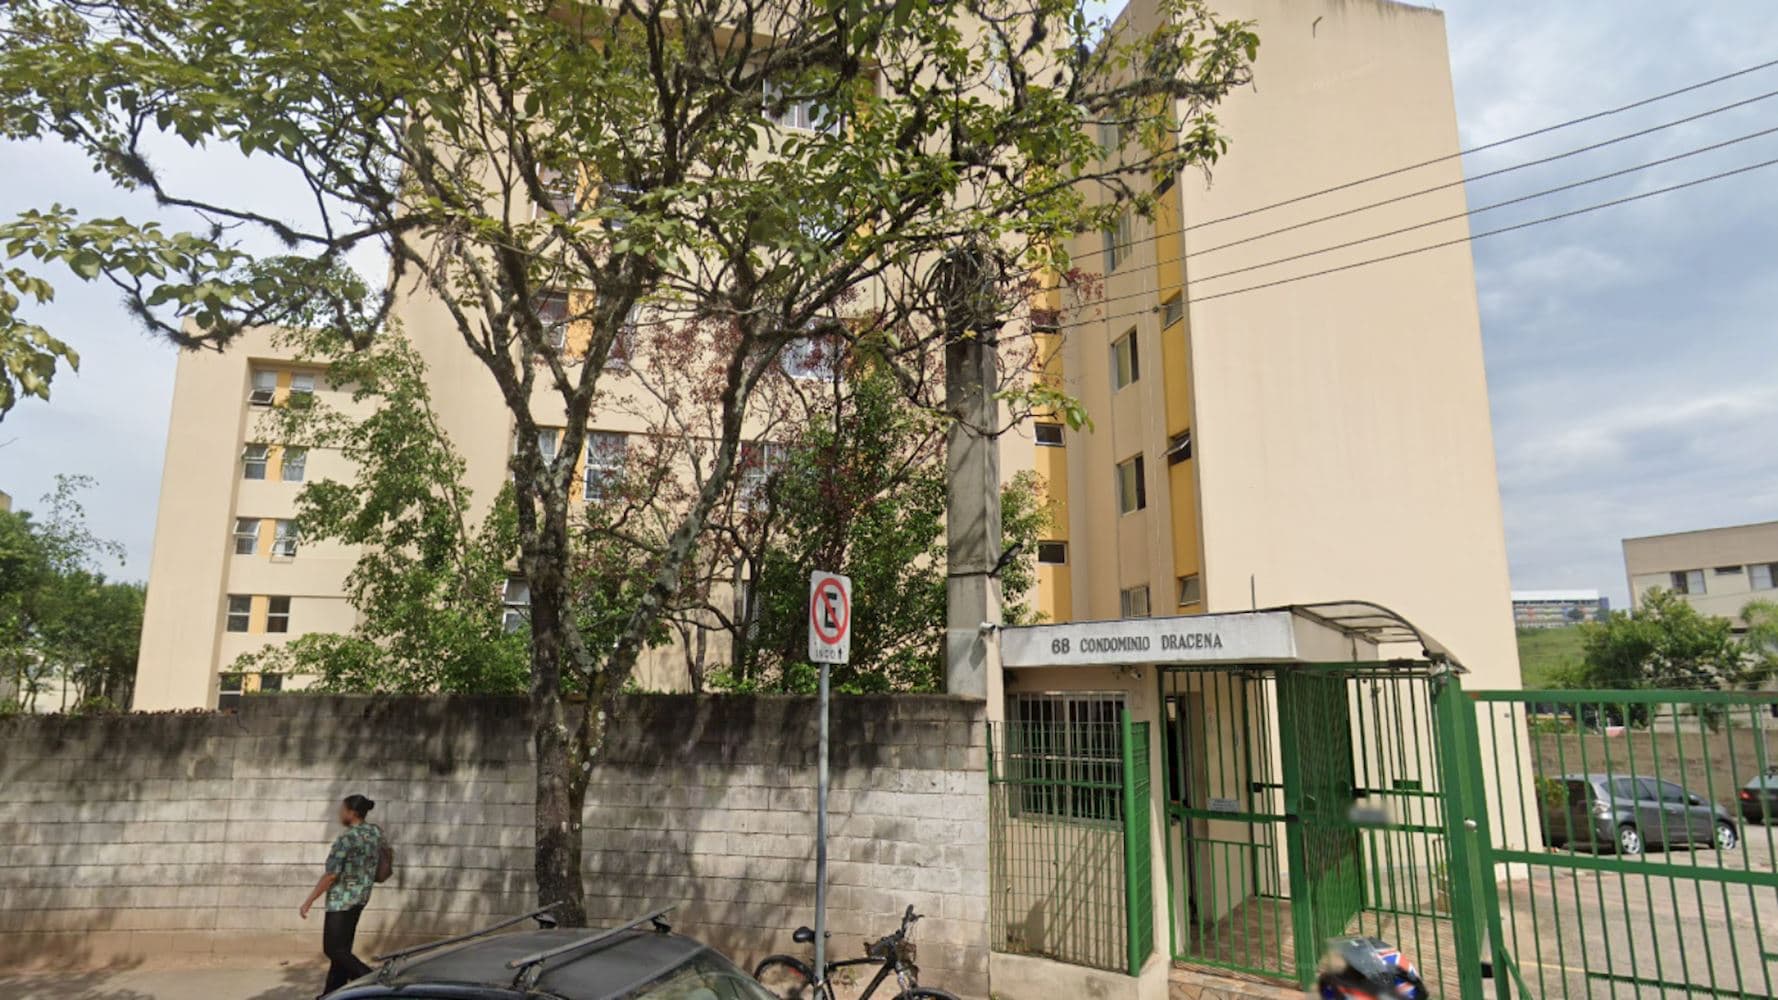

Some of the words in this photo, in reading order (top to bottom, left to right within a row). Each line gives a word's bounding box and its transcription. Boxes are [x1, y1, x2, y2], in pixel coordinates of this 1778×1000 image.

[1052, 637, 1070, 655] 68
[1080, 636, 1150, 653] CONDOMINIO
[1161, 632, 1223, 650] DRACENA
